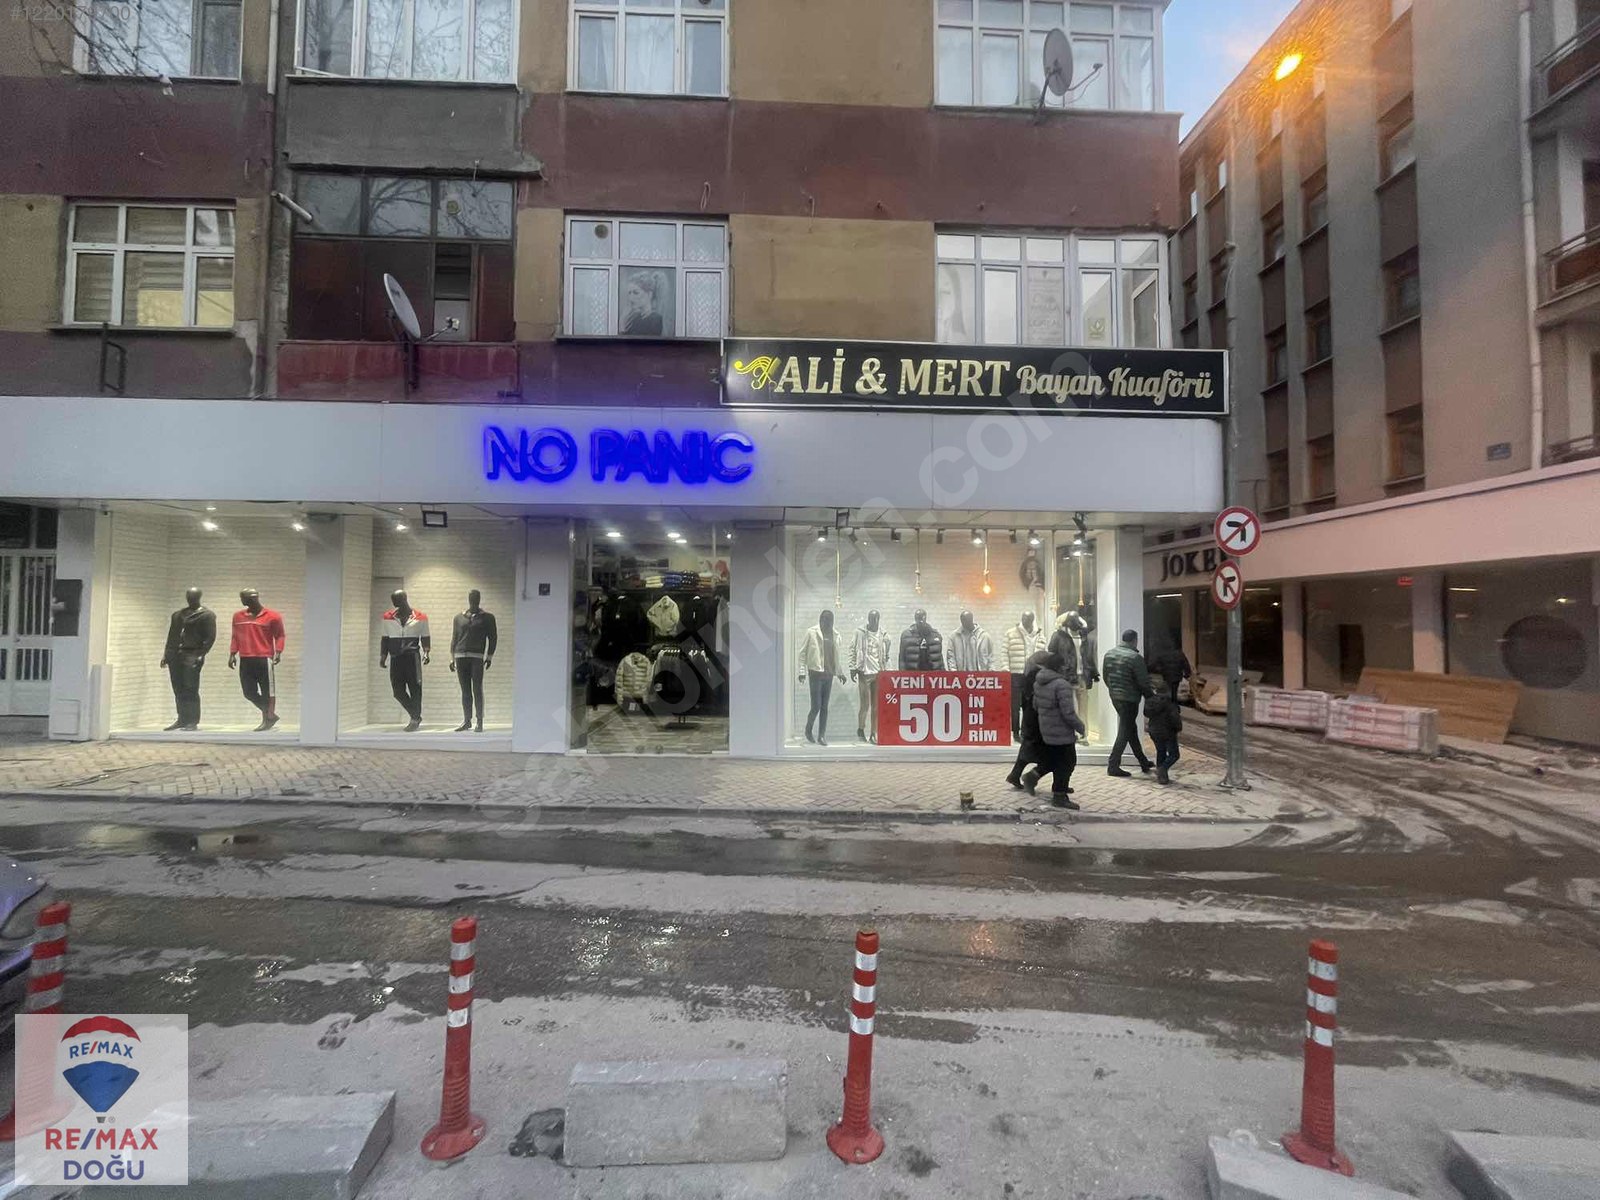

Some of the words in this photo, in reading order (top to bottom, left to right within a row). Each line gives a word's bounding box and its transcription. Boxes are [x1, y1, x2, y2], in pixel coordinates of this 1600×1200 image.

[774, 348, 847, 394] ALİ
[855, 357, 888, 396] &
[897, 358, 1011, 397] MERT
[1016, 365, 1106, 404] Bayan
[1108, 366, 1214, 406] Kuaförü
[484, 426, 578, 483] NO
[590, 428, 754, 484] PANIC
[891, 674, 925, 689] YENİ
[929, 676, 962, 689] YILA
[965, 674, 1003, 689] ÖZEL
[968, 694, 985, 708] İN
[968, 712, 984, 725] Dİ
[968, 727, 998, 742] RİM
